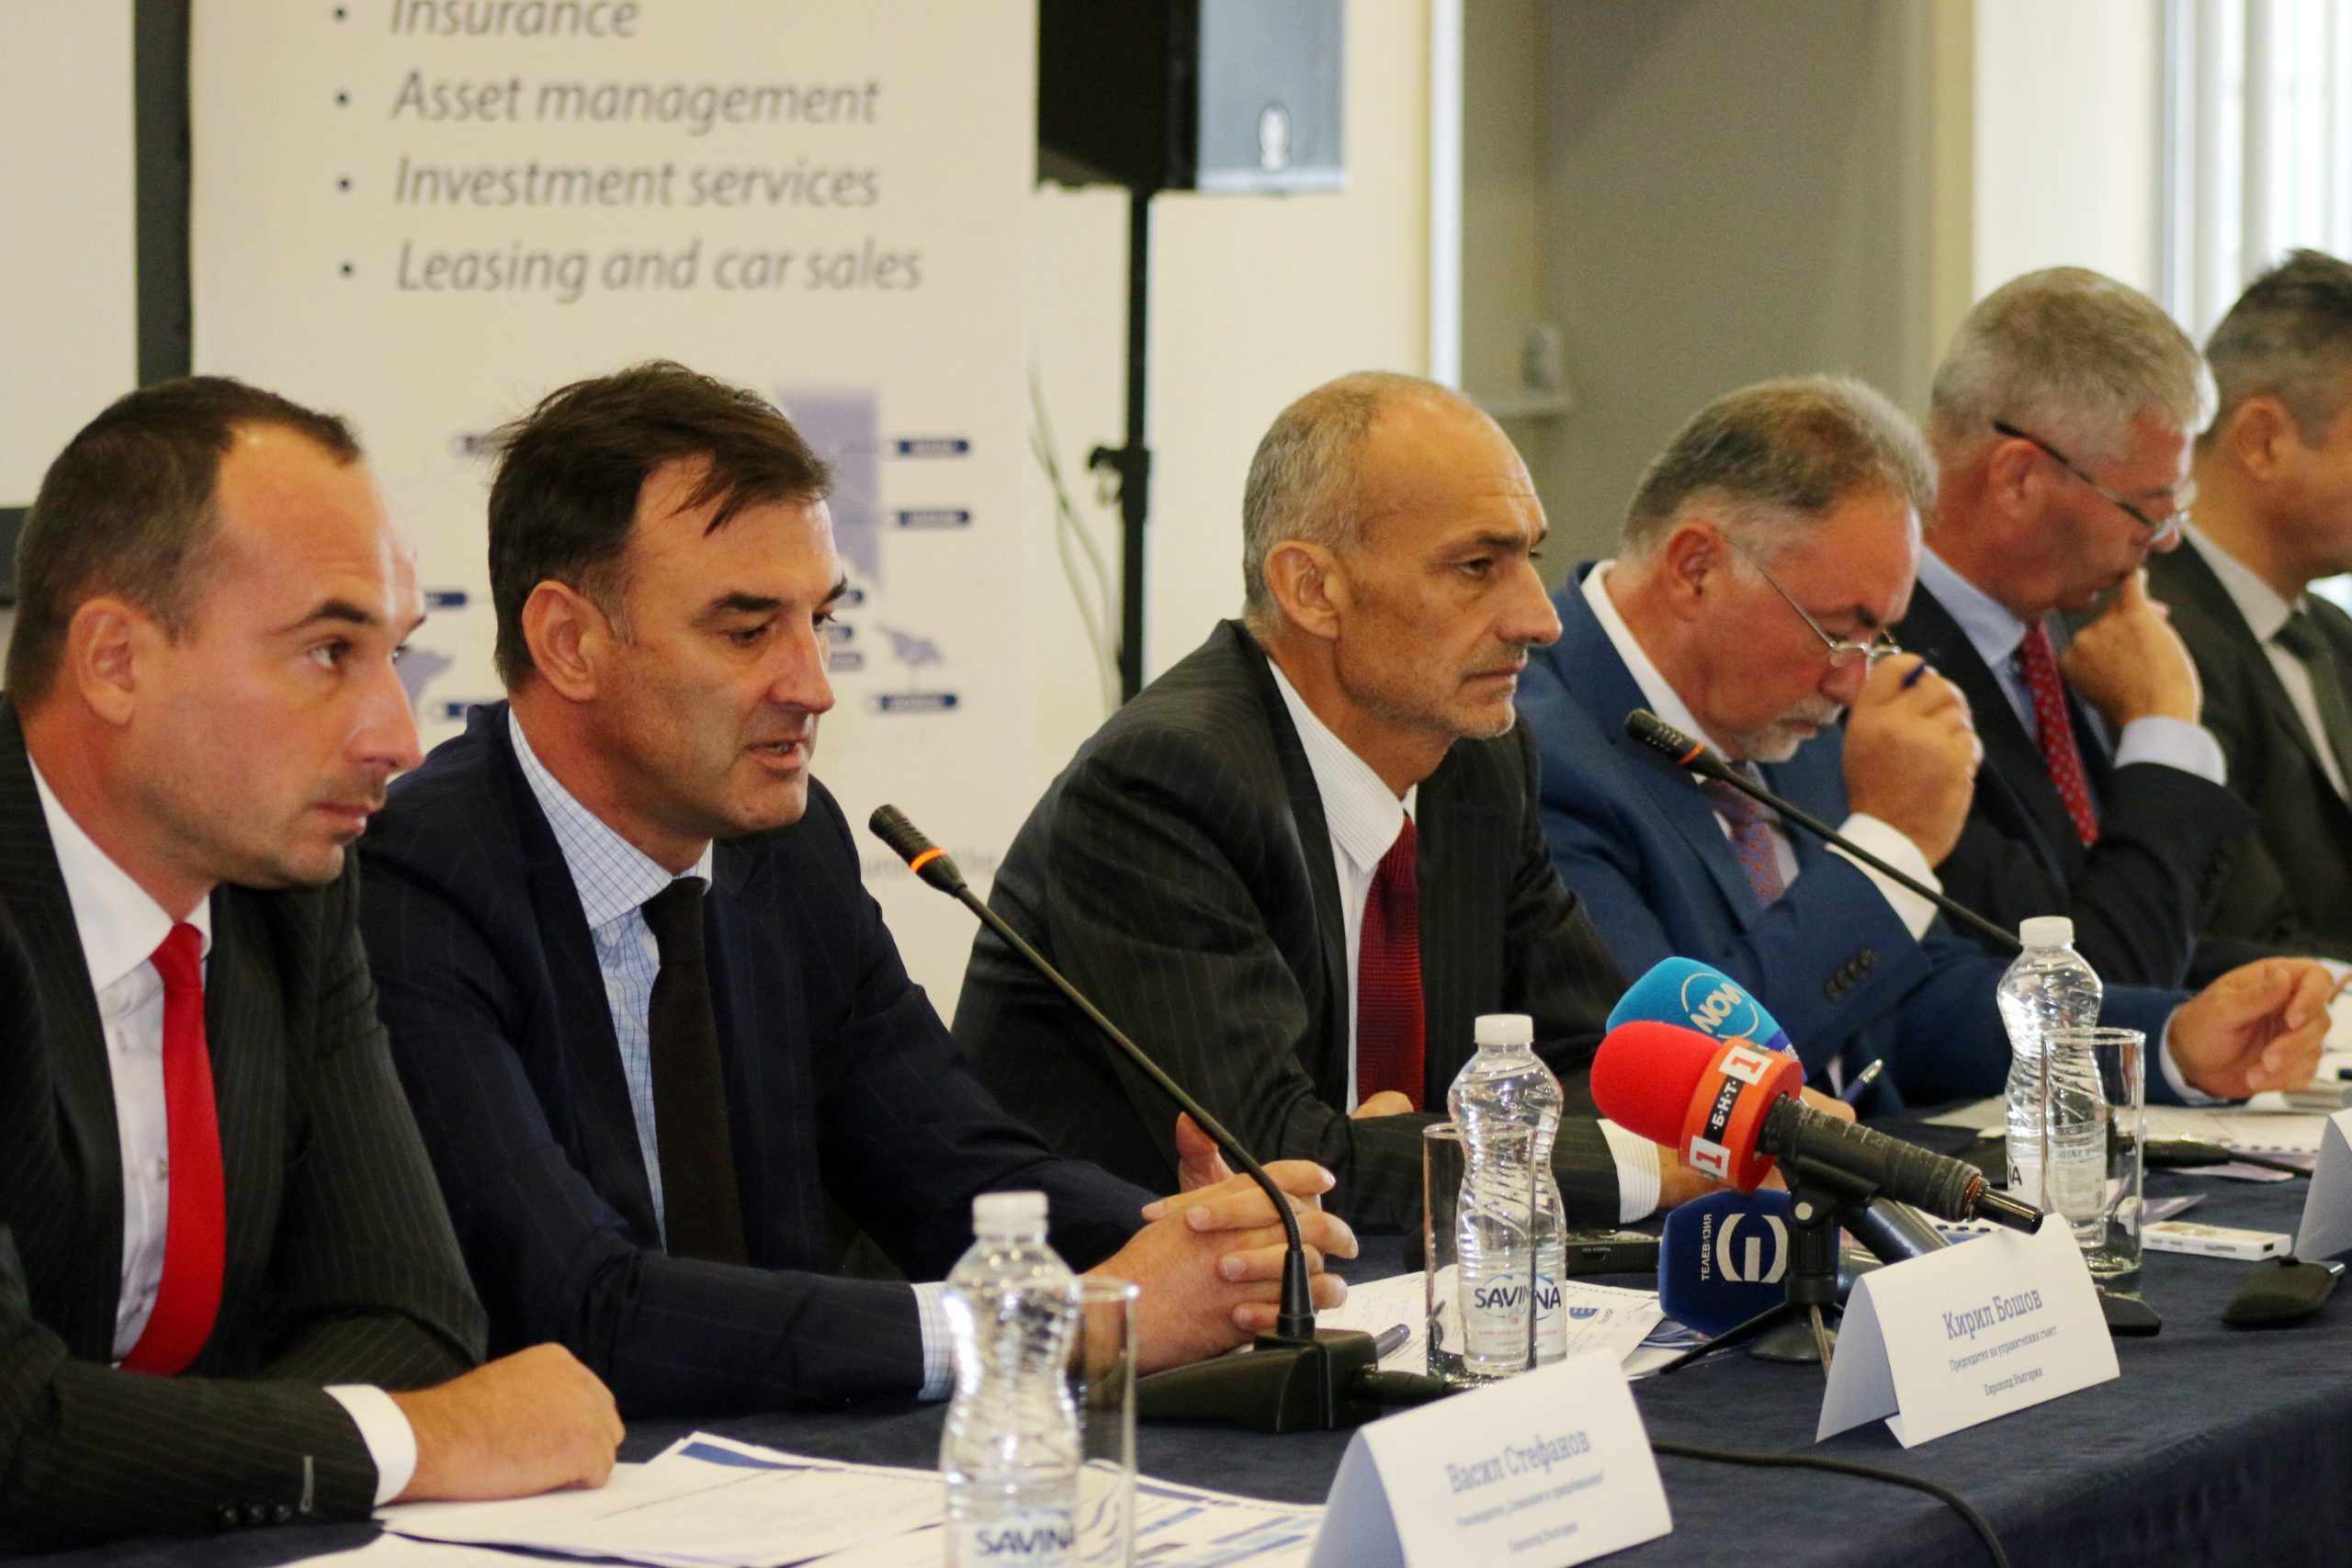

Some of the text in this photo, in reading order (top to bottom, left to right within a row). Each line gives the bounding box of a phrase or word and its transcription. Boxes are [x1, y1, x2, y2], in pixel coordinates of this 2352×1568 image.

[388, 0, 641, 38] Insurance
[390, 70, 879, 137] Asset management
[395, 154, 882, 207] Investment services
[398, 235, 922, 305] Leasing and car sales
[1941, 1289, 2043, 1340] Кирил Бошов
[1445, 1429, 1591, 1495] Васил Стефанов
